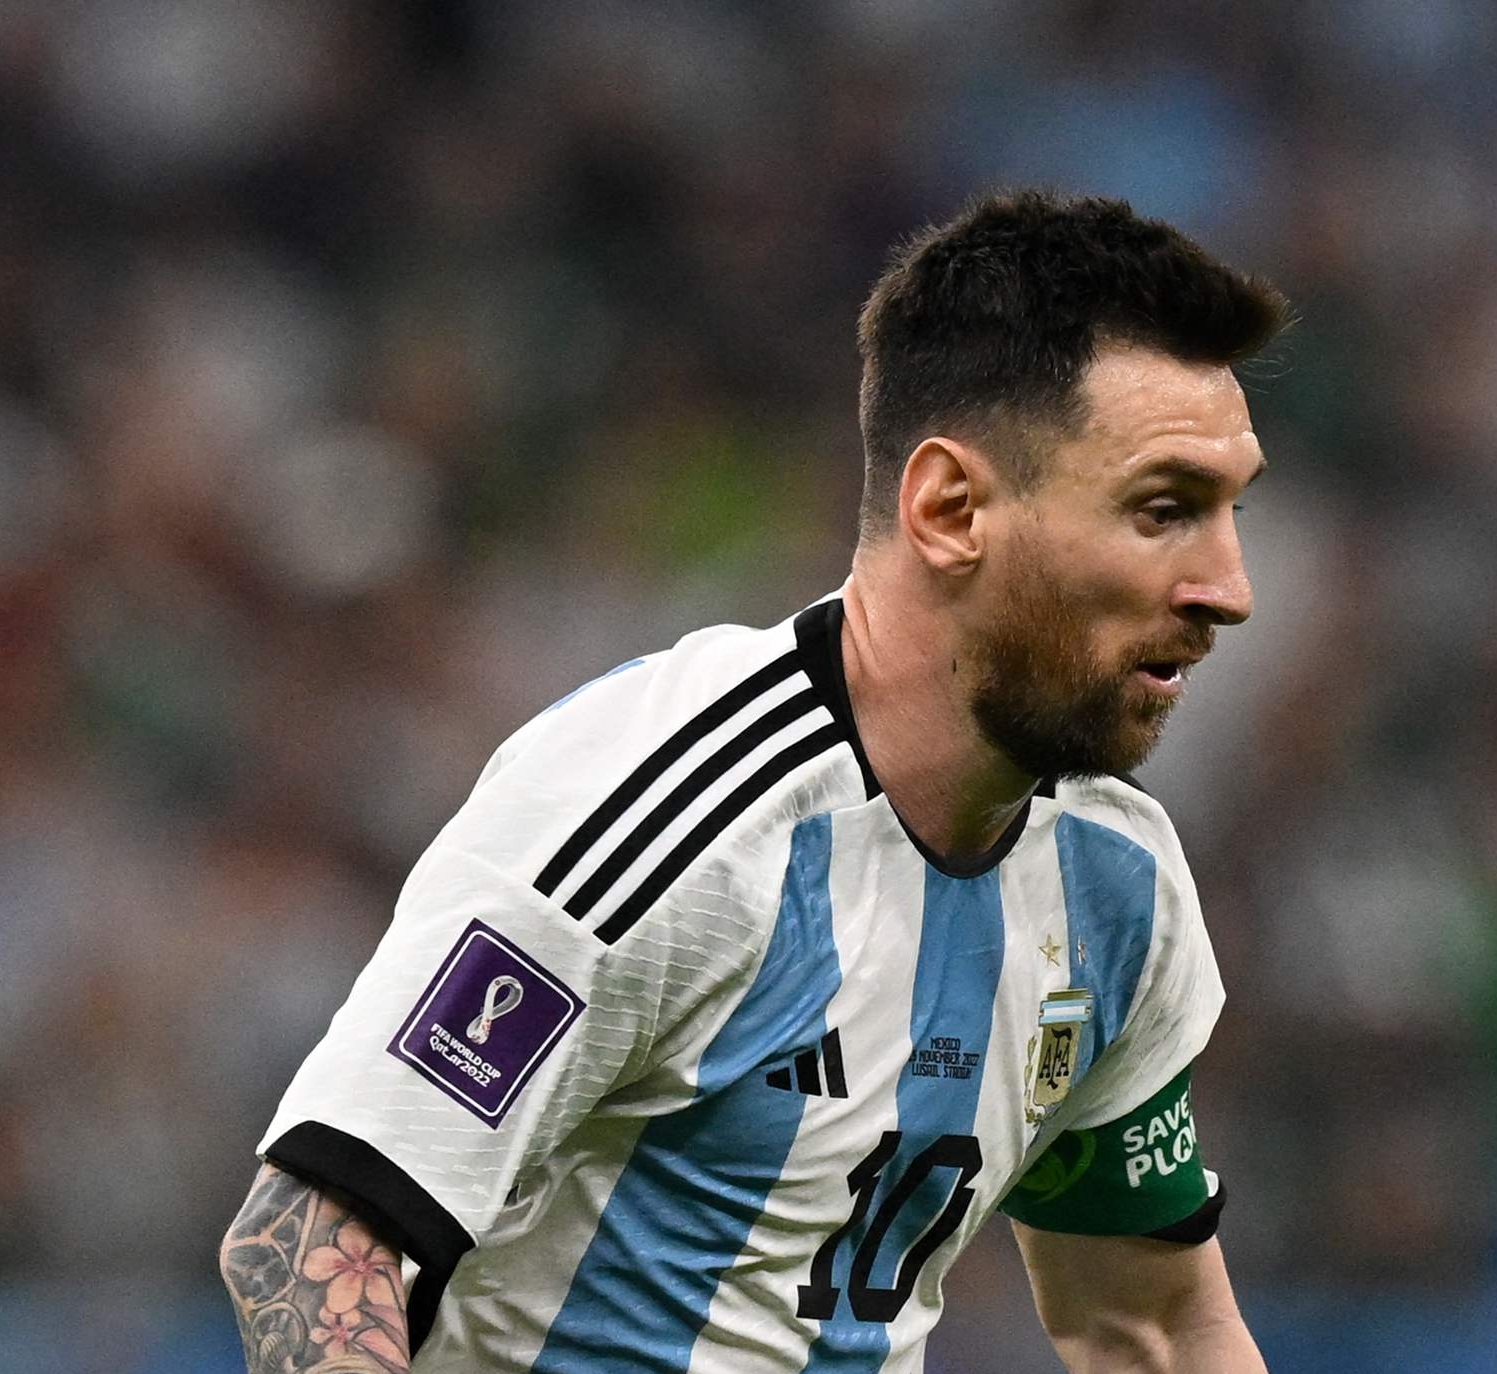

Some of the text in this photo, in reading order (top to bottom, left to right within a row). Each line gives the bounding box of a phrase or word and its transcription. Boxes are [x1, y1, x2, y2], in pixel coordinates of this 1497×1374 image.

[430, 1023, 502, 1079] FIFA WORLD CUP
[930, 1037, 961, 1051] MEXICO
[1123, 1090, 1190, 1153] SAVE
[796, 1130, 983, 1323] 10
